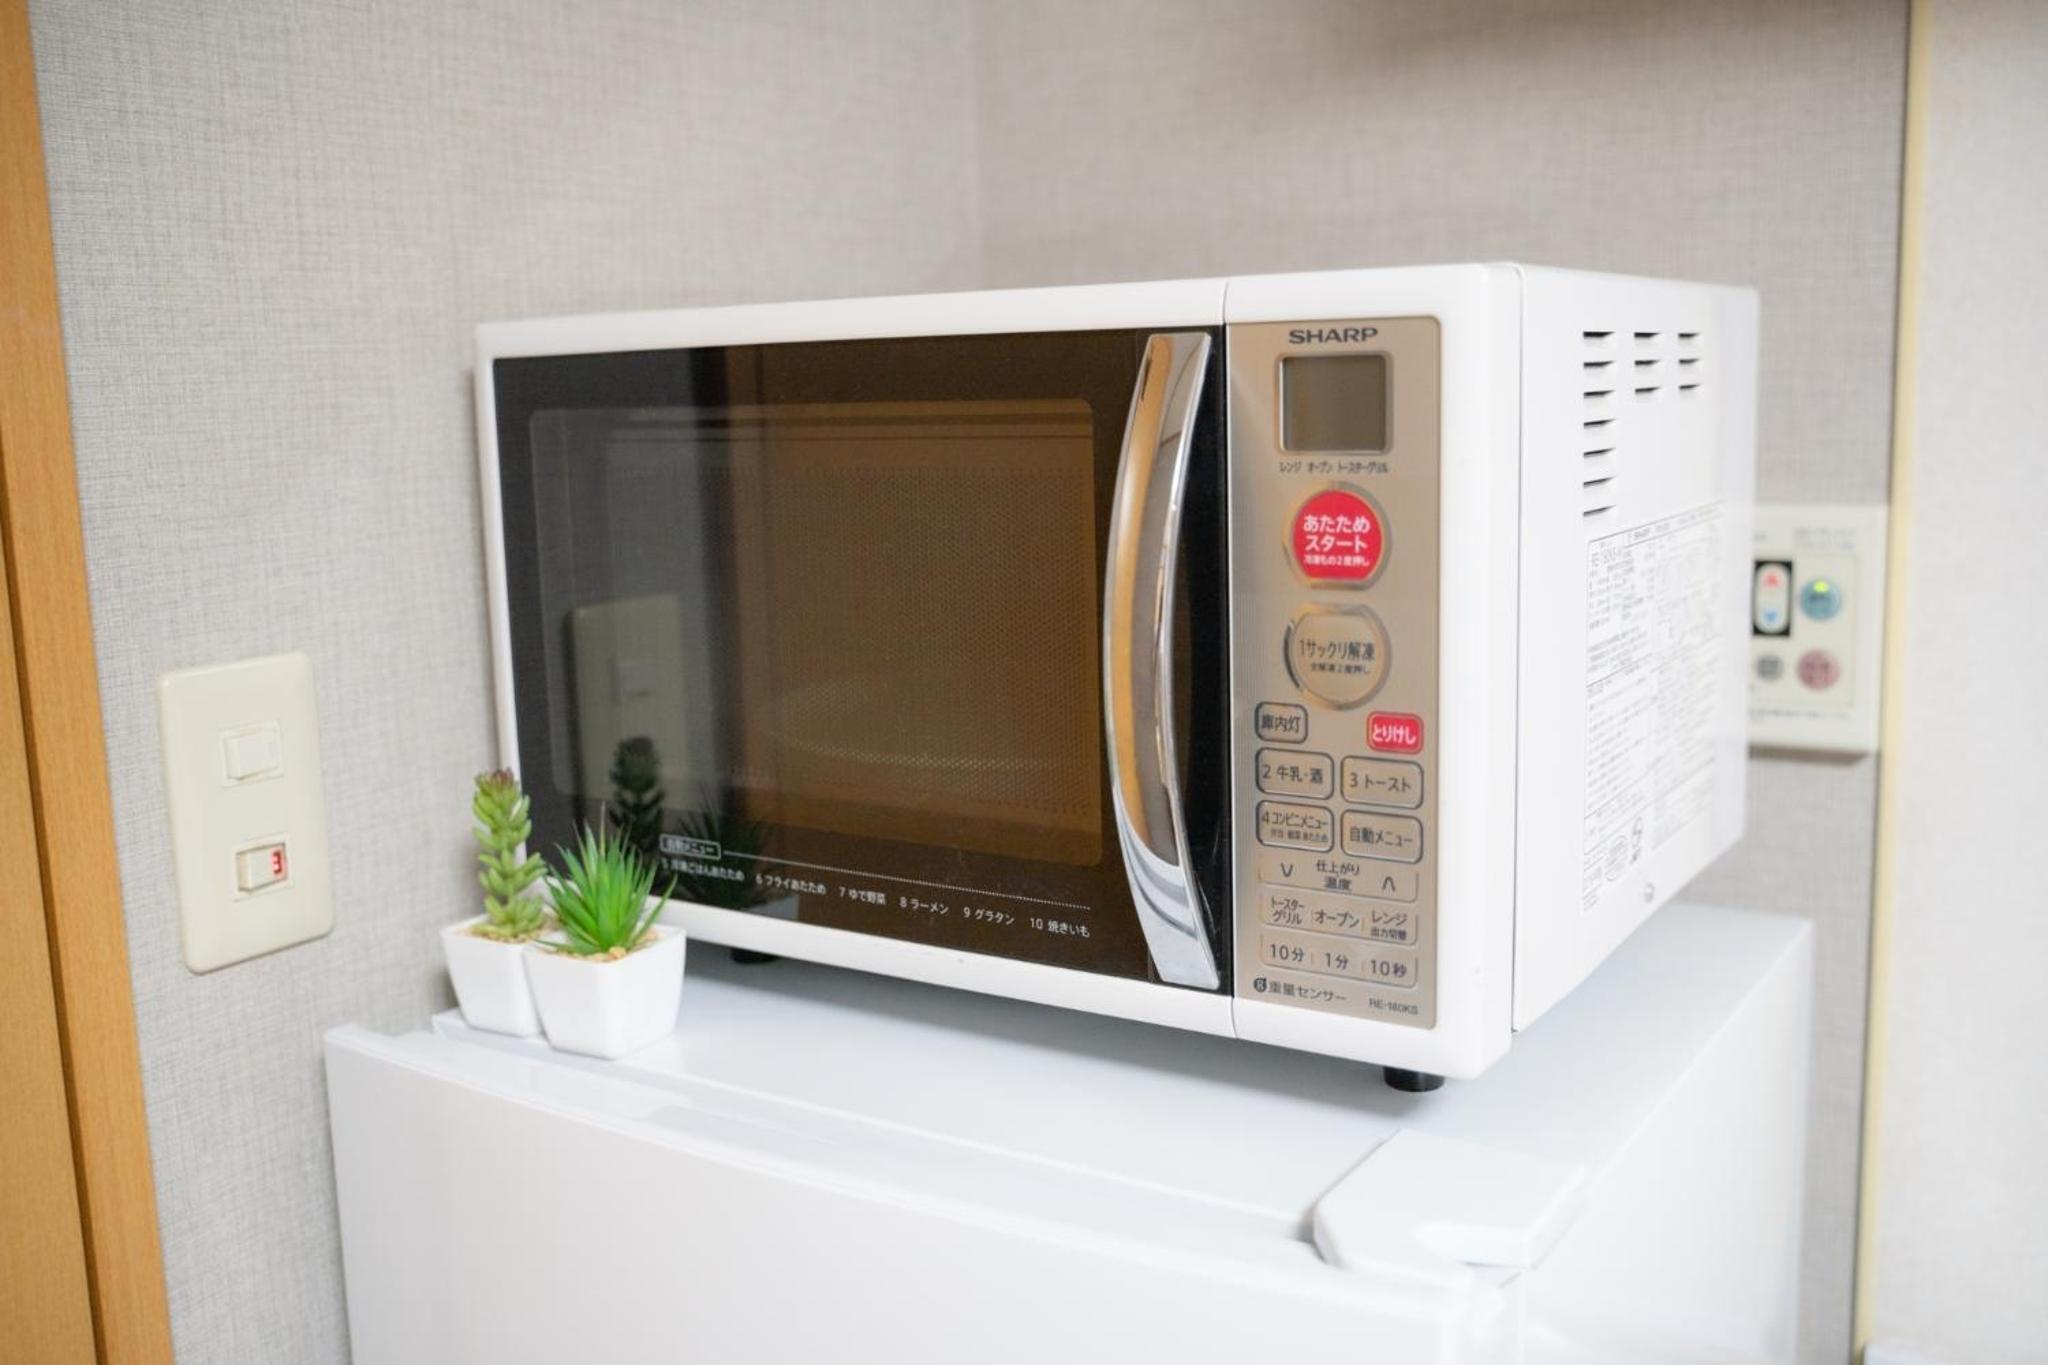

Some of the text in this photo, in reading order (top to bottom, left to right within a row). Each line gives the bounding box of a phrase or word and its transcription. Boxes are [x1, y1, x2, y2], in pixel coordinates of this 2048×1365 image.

[1289, 327, 1378, 344] SHARP
[1303, 515, 1371, 533] あたため
[1305, 534, 1368, 553] スタート
[1262, 714, 1301, 734] 庫内灯
[1371, 724, 1417, 744] とりけし
[1364, 774, 1413, 793] トースト
[1350, 826, 1414, 847] 自動メニュー
[1316, 859, 1361, 875] 仕上がり
[1323, 876, 1352, 891] 温度
[1272, 909, 1302, 926] グリル
[1314, 909, 1360, 929] オープン
[1371, 910, 1408, 926] レンジ
[1270, 943, 1305, 962] 10分
[1325, 952, 1349, 970] 1分
[1371, 959, 1408, 977] 10秒
